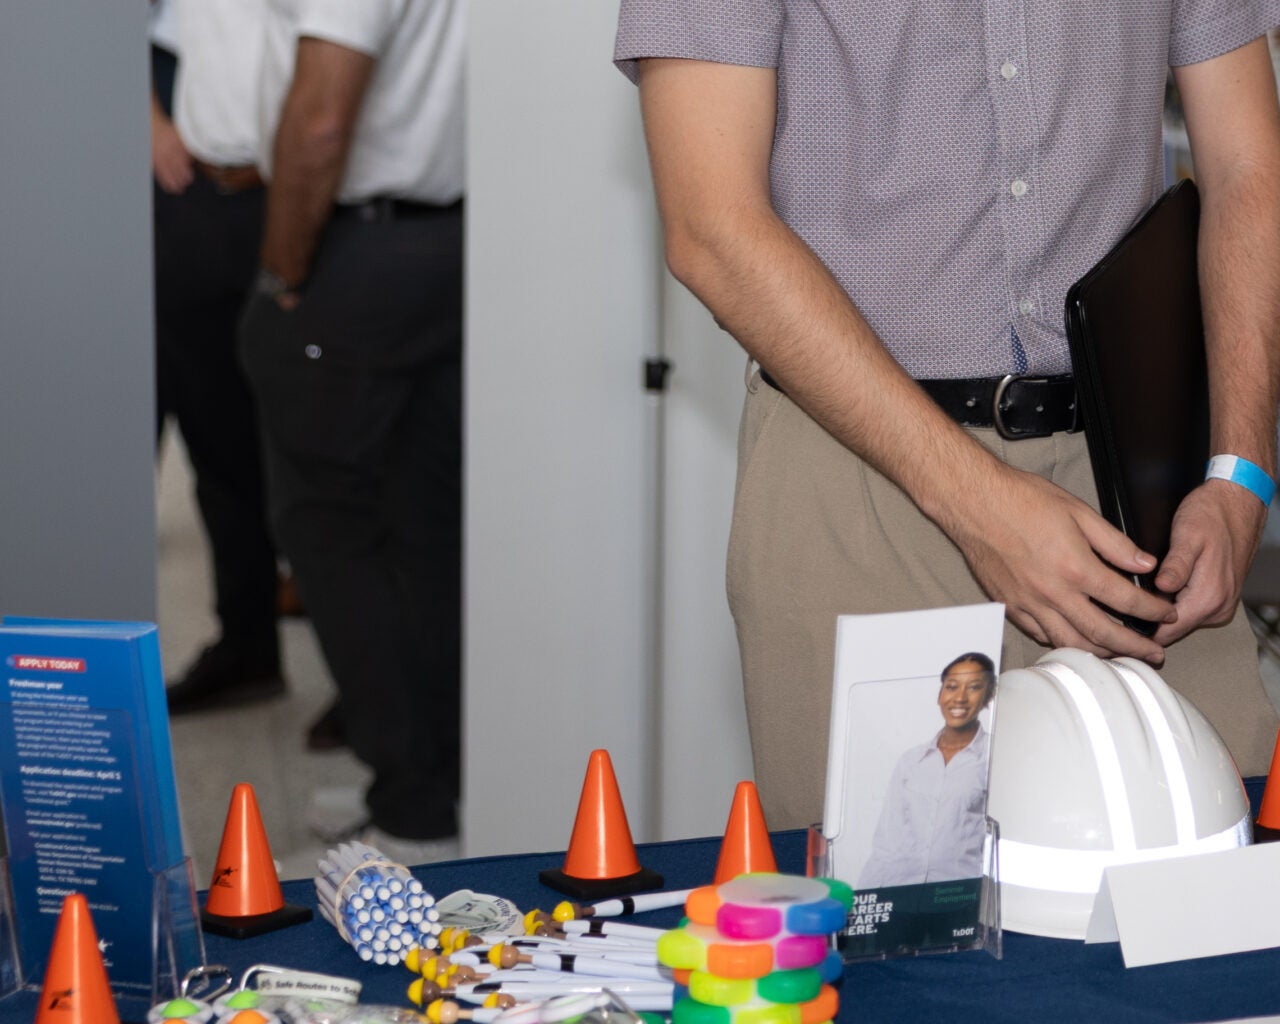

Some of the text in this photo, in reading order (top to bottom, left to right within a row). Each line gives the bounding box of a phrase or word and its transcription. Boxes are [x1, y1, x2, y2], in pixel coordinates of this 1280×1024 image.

[19, 658, 80, 670] APPLY TODAY
[851, 902, 893, 916] AREER
[848, 912, 890, 926] TARTS
[952, 927, 975, 937] TxDOT
